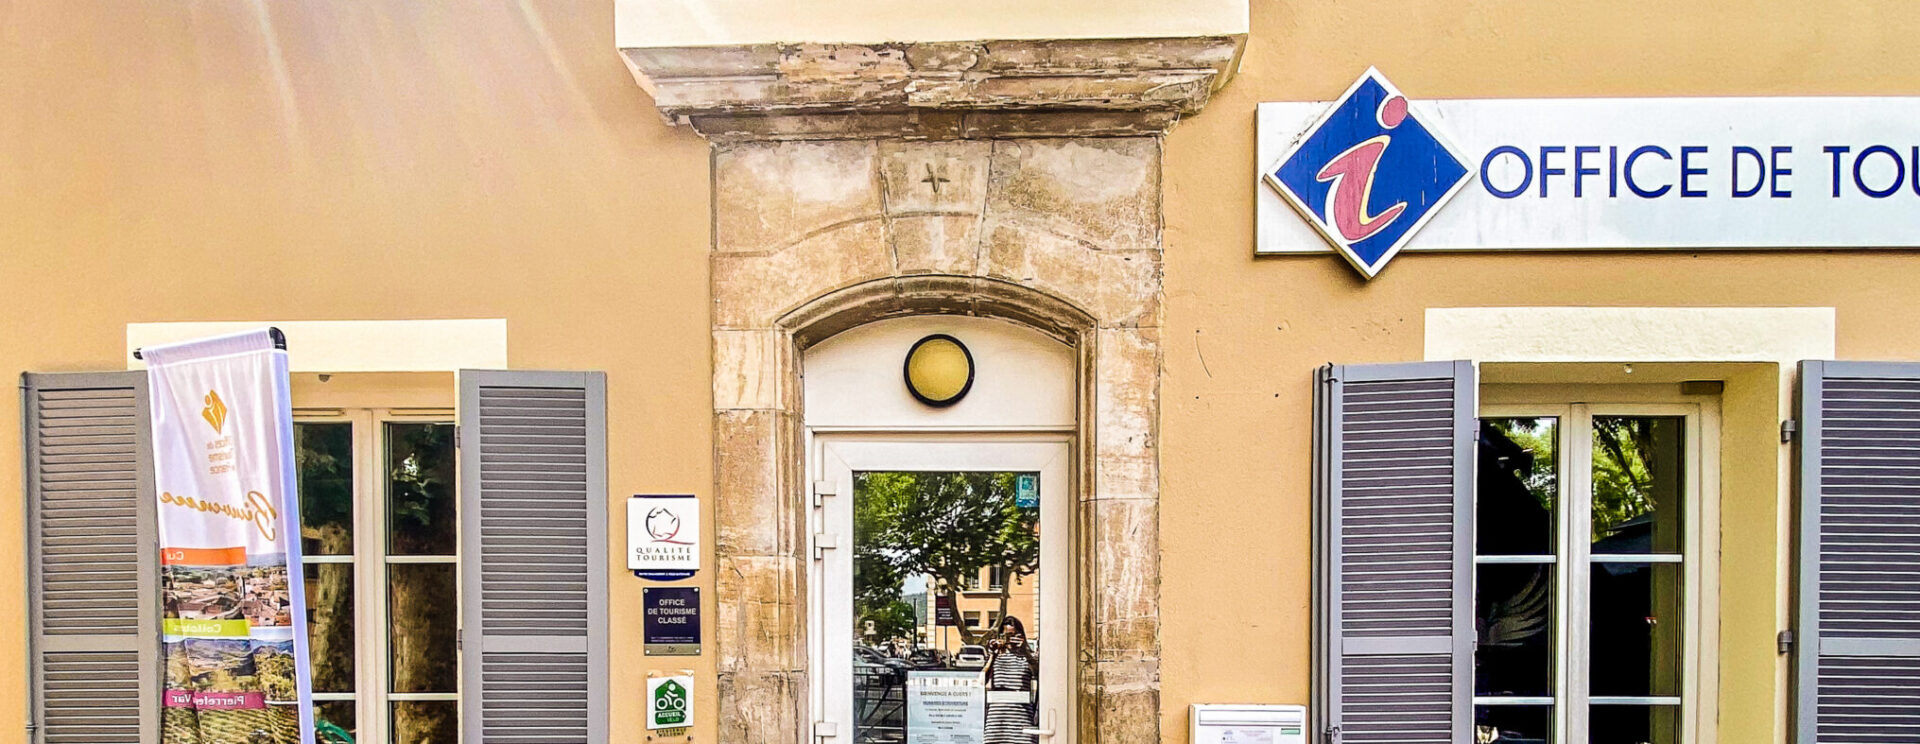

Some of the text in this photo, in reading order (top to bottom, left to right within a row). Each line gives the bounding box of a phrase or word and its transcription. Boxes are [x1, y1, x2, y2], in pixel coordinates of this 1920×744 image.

[1480, 144, 1920, 199] OFFICE DE TO
